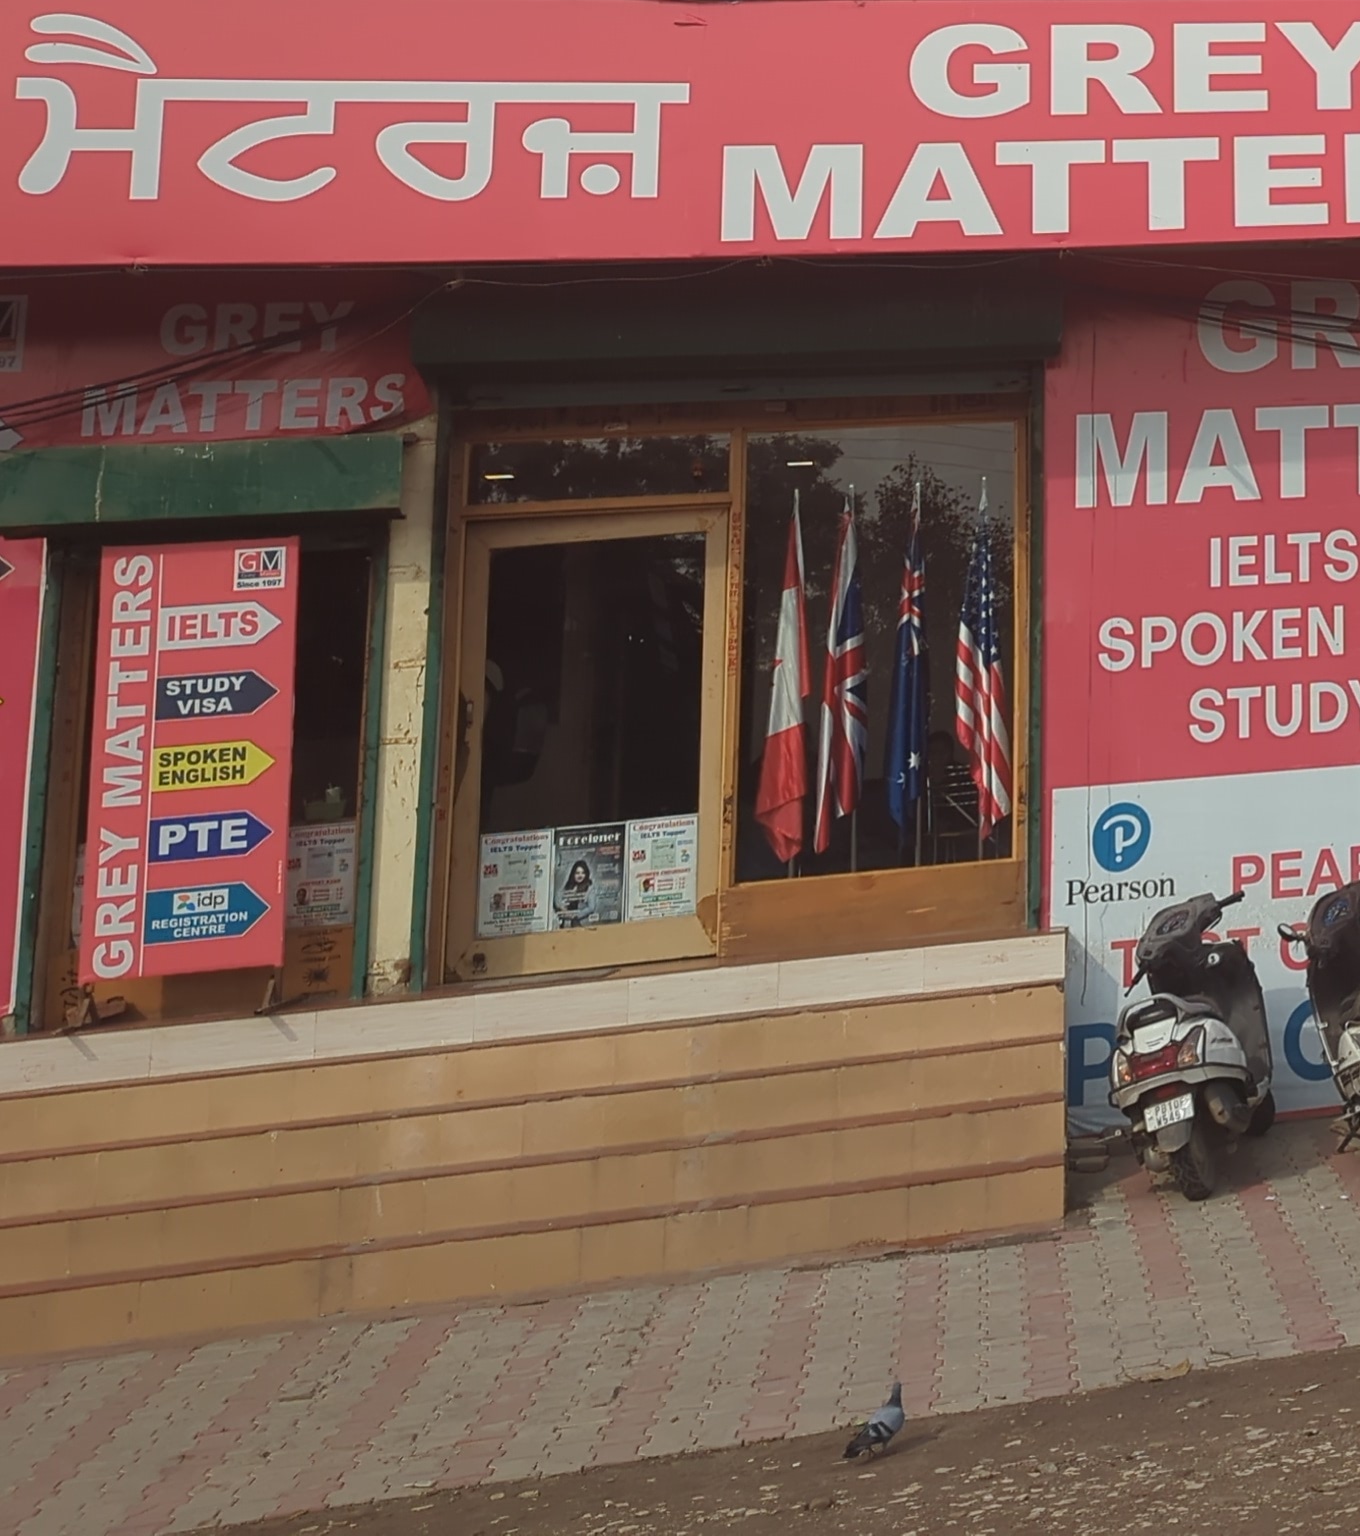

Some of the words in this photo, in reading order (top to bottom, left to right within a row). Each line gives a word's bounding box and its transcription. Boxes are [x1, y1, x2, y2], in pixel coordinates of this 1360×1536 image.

[160, 301, 355, 355] GREY
[80, 374, 406, 437] MATTERS
[239, 551, 282, 572] GM
[1209, 529, 1358, 588] IELTS
[236, 581, 260, 589] Since
[167, 610, 259, 642] IELTS
[1097, 604, 1345, 672] SPOKEN
[102, 554, 154, 808] MATTERS
[166, 675, 246, 696] STUDY
[176, 697, 233, 715] VISA
[158, 746, 247, 768] SPOKEN
[158, 764, 245, 786] ENGLISH
[158, 818, 248, 856] PTE
[92, 827, 140, 980] GREY
[197, 893, 225, 909] idp
[1065, 877, 1175, 906] Pearson
[151, 911, 248, 930] REGISTRATION
[173, 924, 226, 939] CENTRE
